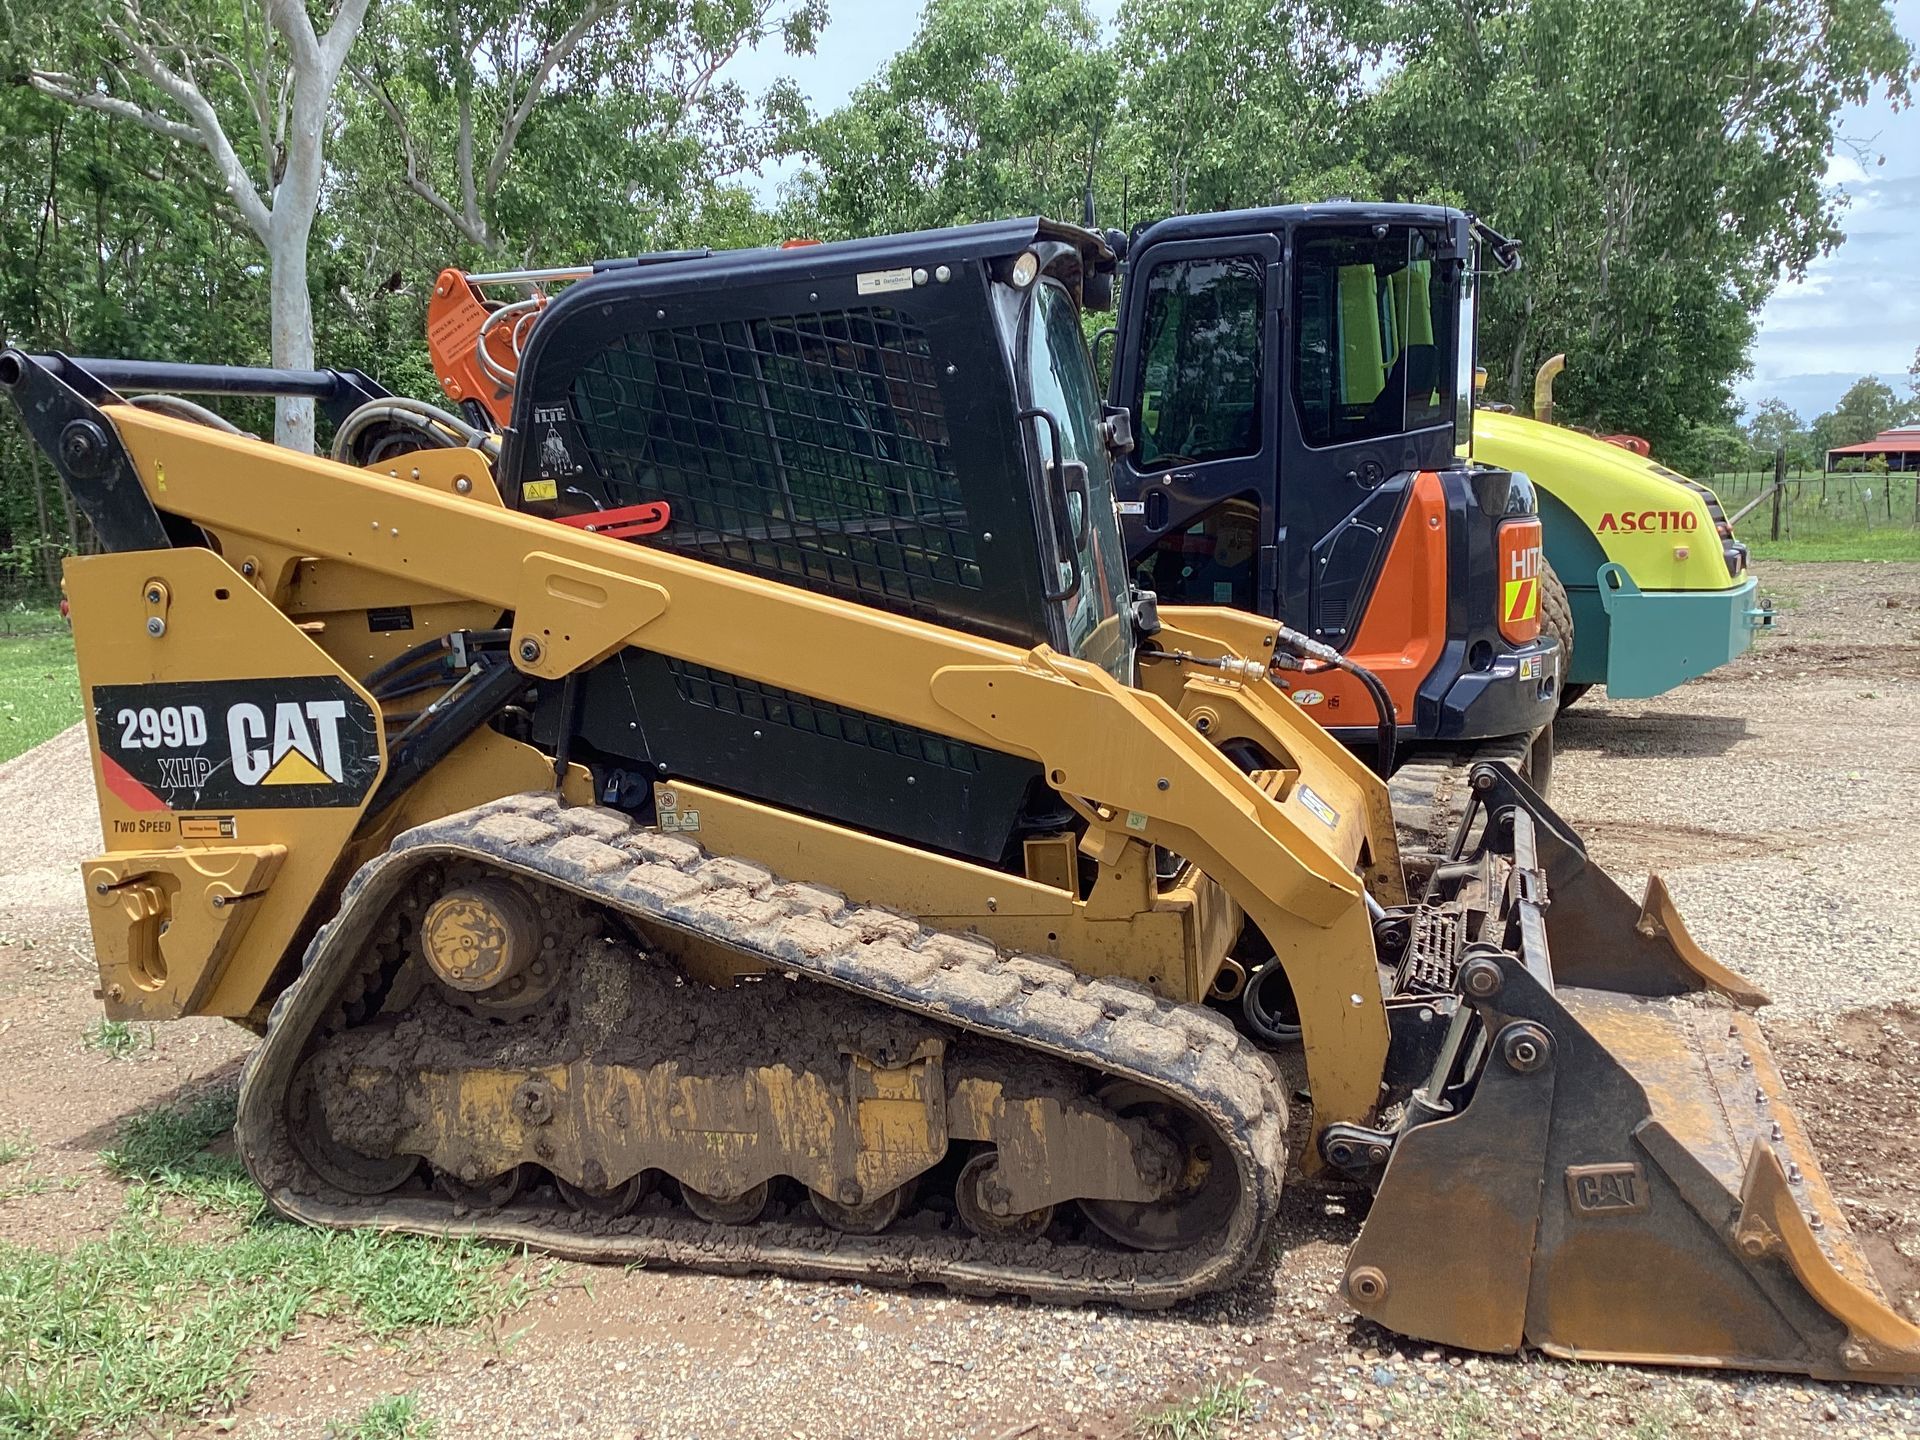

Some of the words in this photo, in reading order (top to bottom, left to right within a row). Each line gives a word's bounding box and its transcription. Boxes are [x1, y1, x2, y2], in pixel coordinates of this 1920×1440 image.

[1596, 511, 1697, 534] ASC110
[117, 706, 208, 748] 299D
[226, 700, 346, 786] CAT
[158, 757, 212, 788] XHP
[1577, 1173, 1636, 1209] CAT
